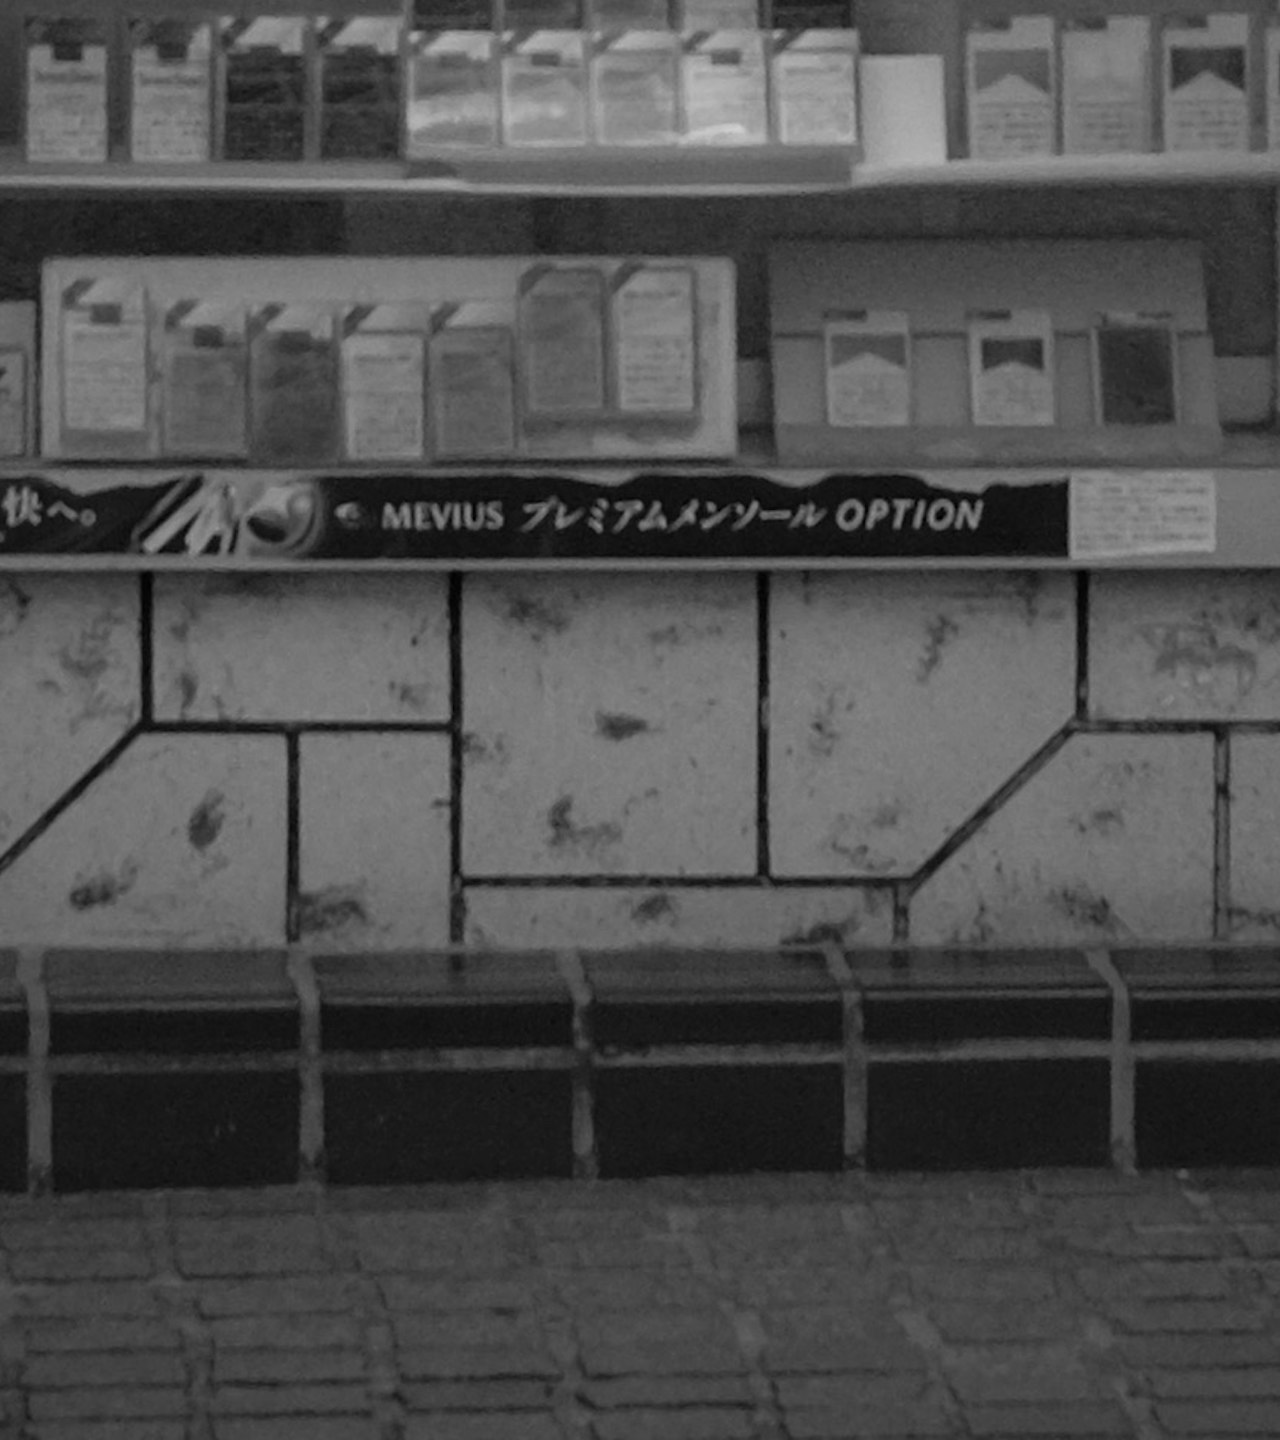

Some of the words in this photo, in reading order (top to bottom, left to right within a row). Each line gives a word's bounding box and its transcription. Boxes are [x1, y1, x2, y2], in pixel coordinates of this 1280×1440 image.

[381, 499, 506, 532] MEVIUS
[519, 495, 828, 534] プレミアムメンソール
[835, 495, 986, 533] OPTION
